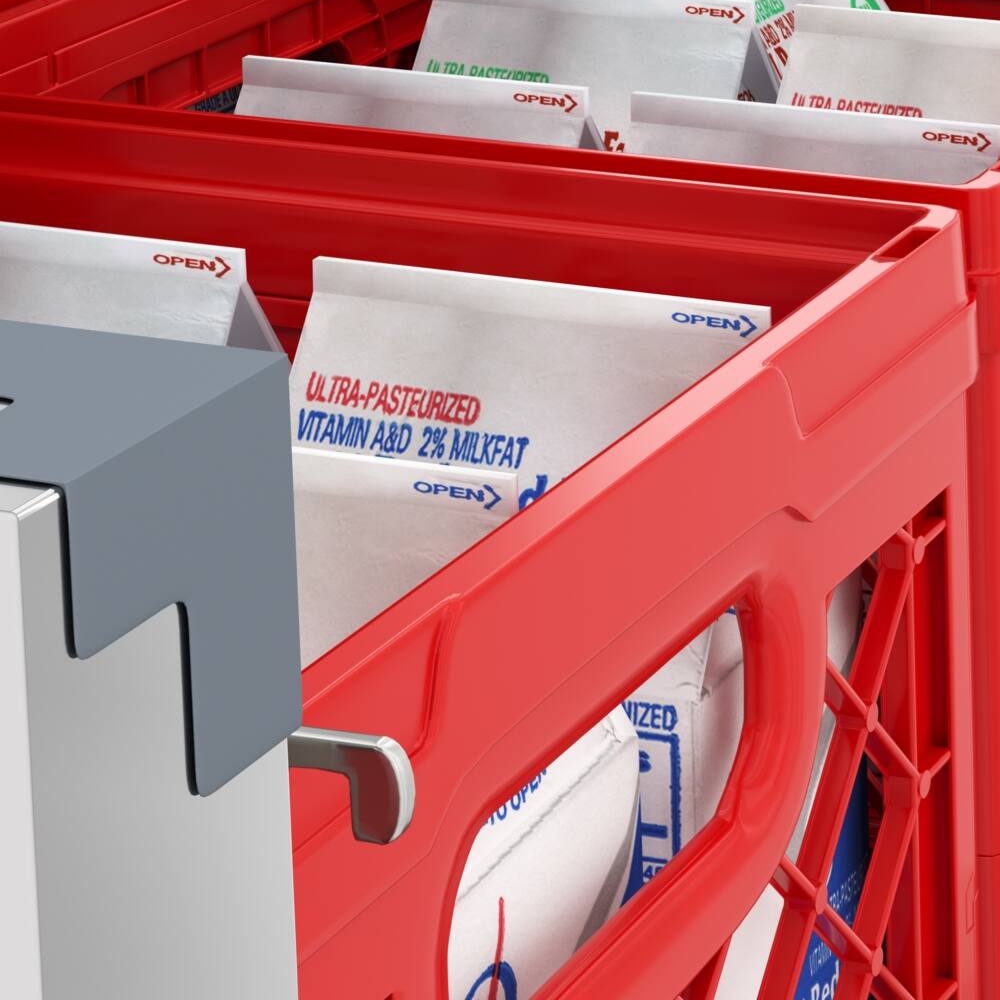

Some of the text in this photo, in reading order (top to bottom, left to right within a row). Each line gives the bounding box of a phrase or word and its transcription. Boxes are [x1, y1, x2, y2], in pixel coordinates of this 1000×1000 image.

[685, 5, 734, 19] OPEN
[513, 92, 566, 108] OPEN
[922, 131, 979, 147] OPEN
[153, 253, 217, 272] OPEN
[671, 311, 741, 331] OPEN
[306, 371, 481, 426] ULTRA-PASTEURIZED
[297, 408, 372, 449] VITAMIN
[370, 420, 412, 455] A&D
[417, 426, 449, 460] 2%
[448, 428, 530, 470] MILKFAT
[413, 480, 485, 503] OPEN
